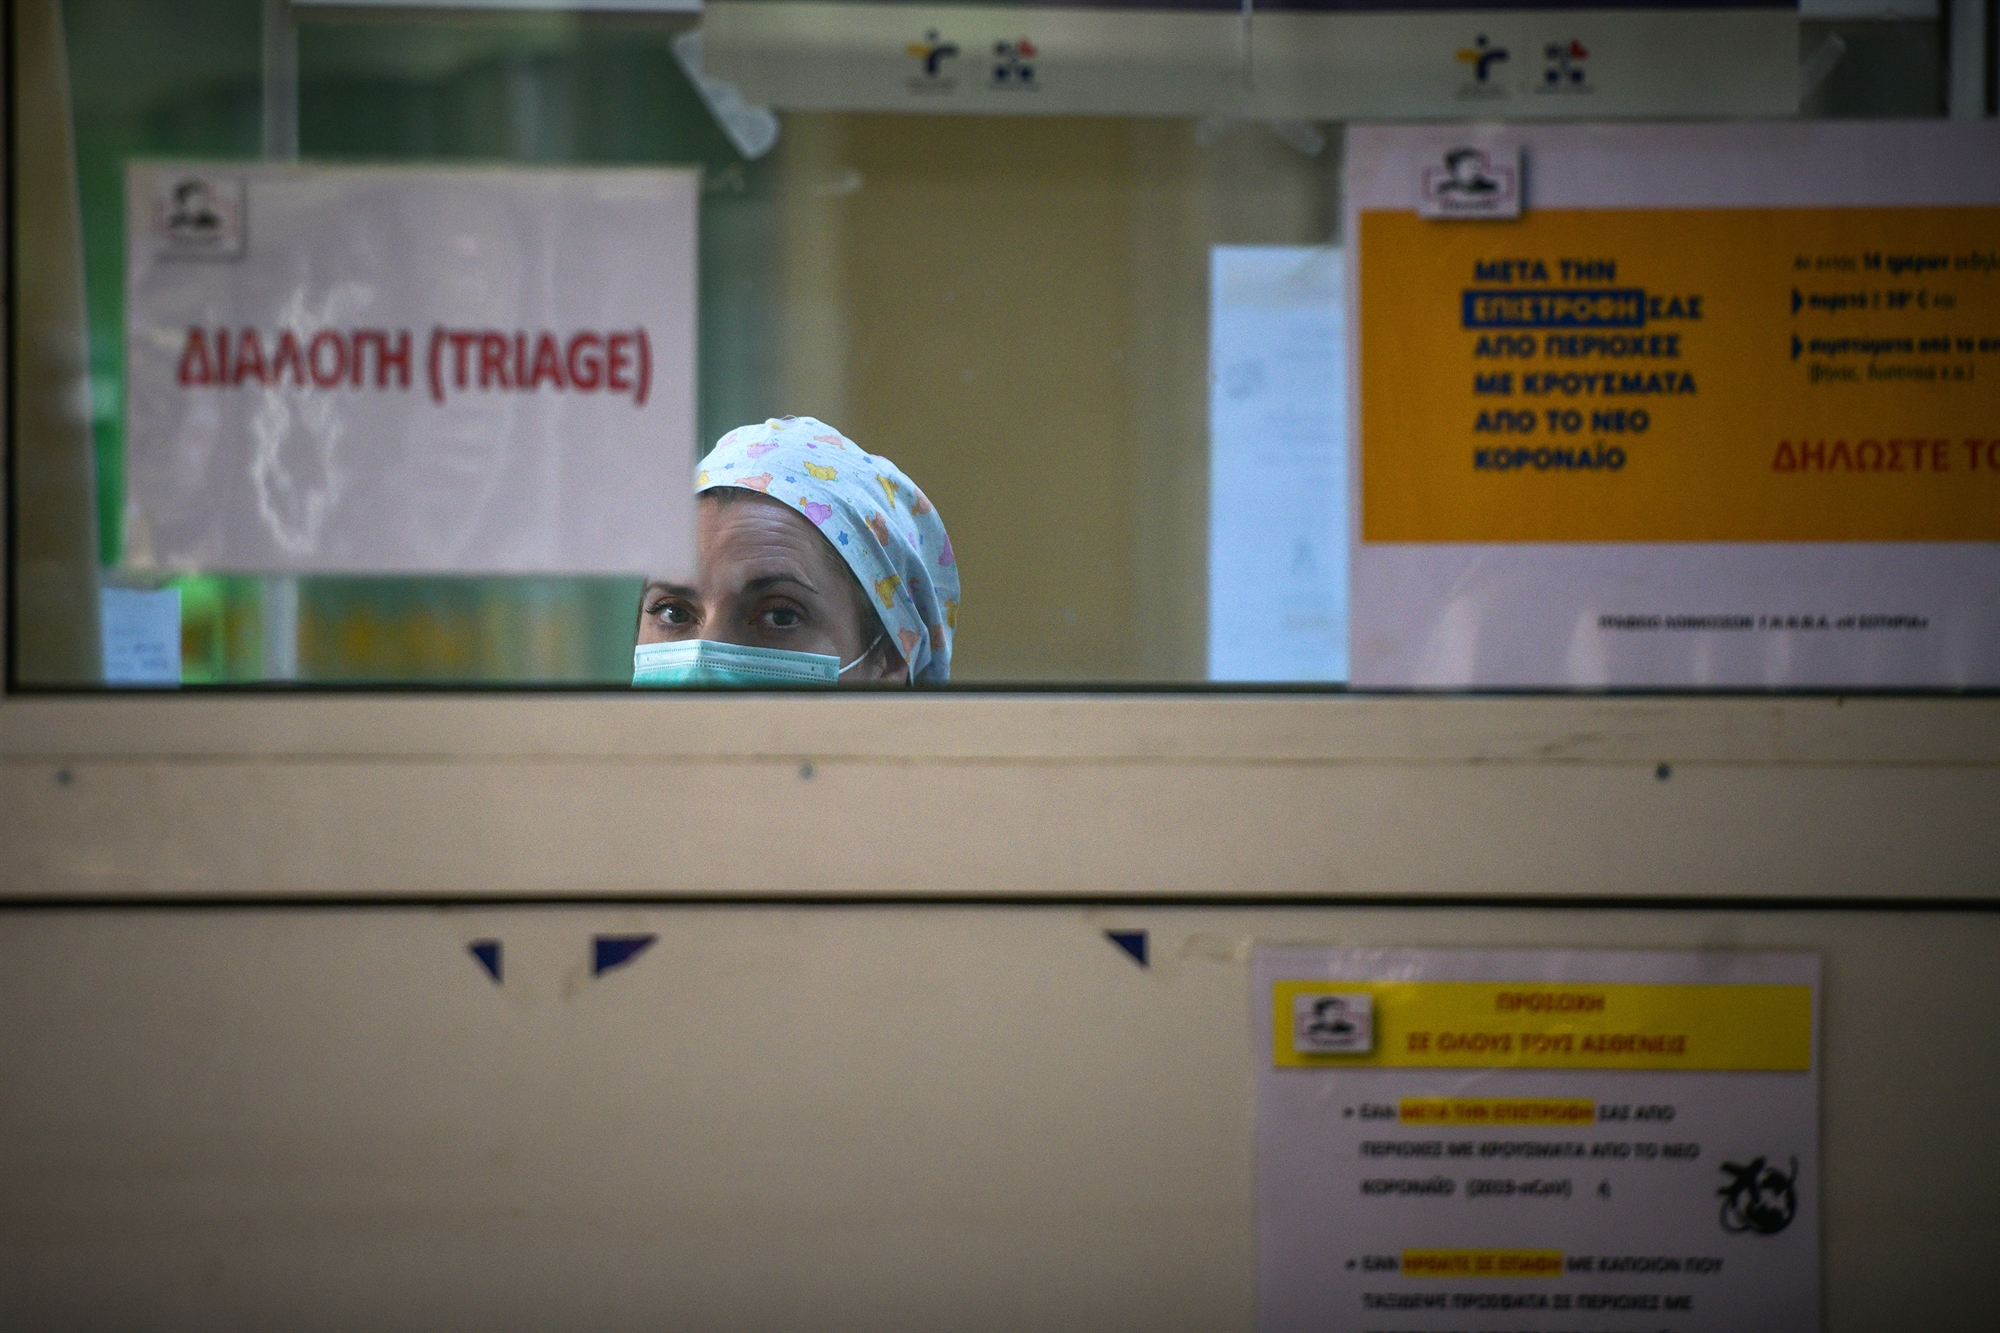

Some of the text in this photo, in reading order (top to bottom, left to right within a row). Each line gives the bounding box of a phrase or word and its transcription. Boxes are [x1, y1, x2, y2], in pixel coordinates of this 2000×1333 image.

[1474, 260, 1616, 282] ΜΕΤΑ ΤΗΝ
[1473, 296, 1702, 321] ΕΠΙΣΤΡΟΦΗ ΣΑΣ
[1474, 335, 1681, 357] ΑΠΟ ΠΕΡΙΟΧΕΣ
[178, 323, 653, 405] ΔΙΑΛΟΓΗ (TRIAGE)
[1474, 372, 1696, 395] ΜΕ ΚΡΟΥΣΜΑΤΑ
[1474, 410, 1650, 432] ΑΠΟ ΤΟ ΝΕΟ
[1771, 439, 1949, 471] ΔΗΛΩΣΤΕ
[1408, 1033, 1431, 1052] ΣΕ
